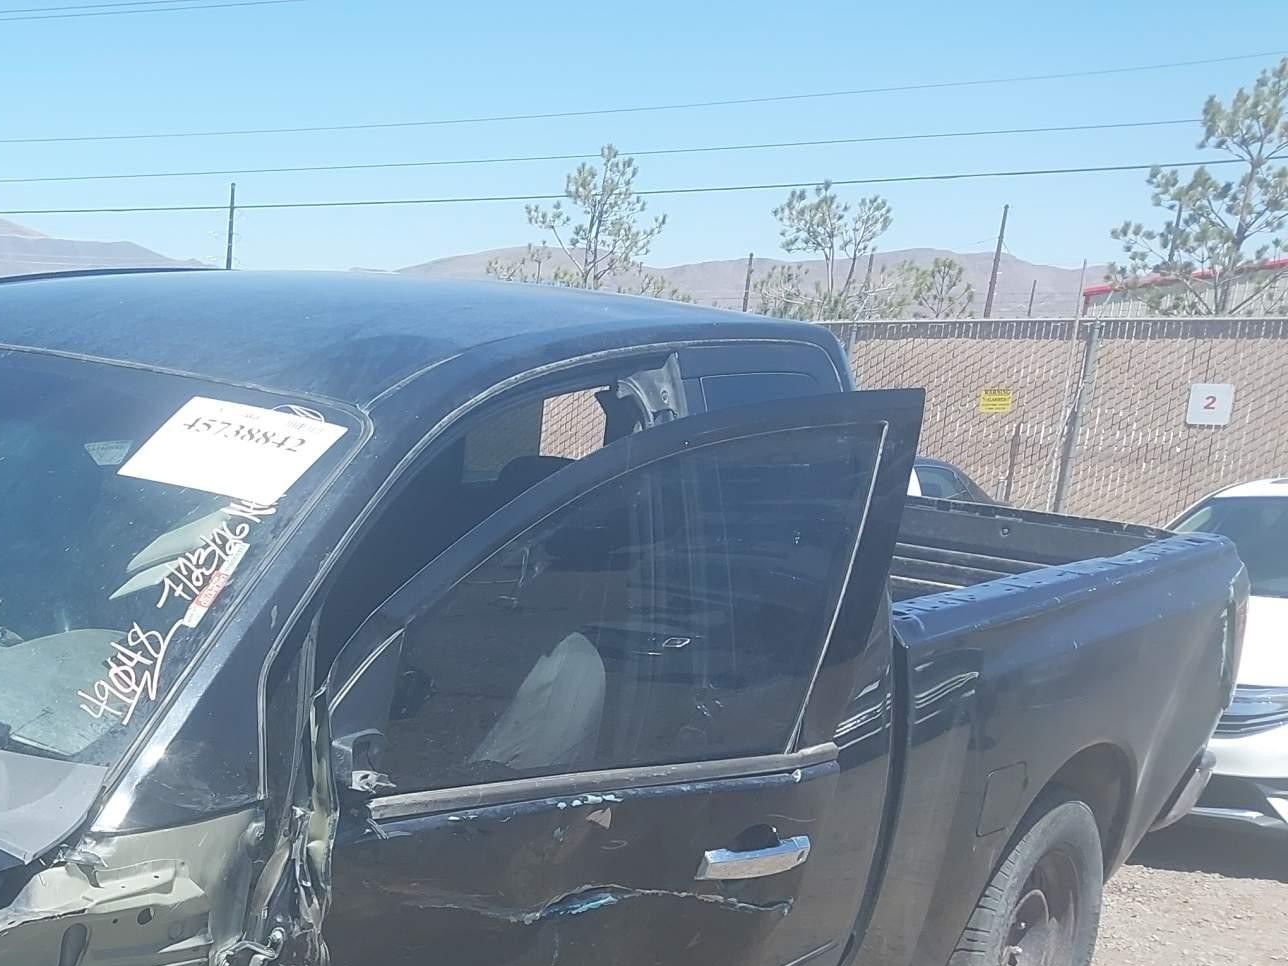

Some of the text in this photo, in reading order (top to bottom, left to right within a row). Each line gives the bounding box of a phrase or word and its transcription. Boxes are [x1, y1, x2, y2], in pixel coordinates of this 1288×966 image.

[1203, 395, 1217, 410] 2
[183, 416, 307, 453] 45738842
[156, 520, 250, 608] 7/23/26
